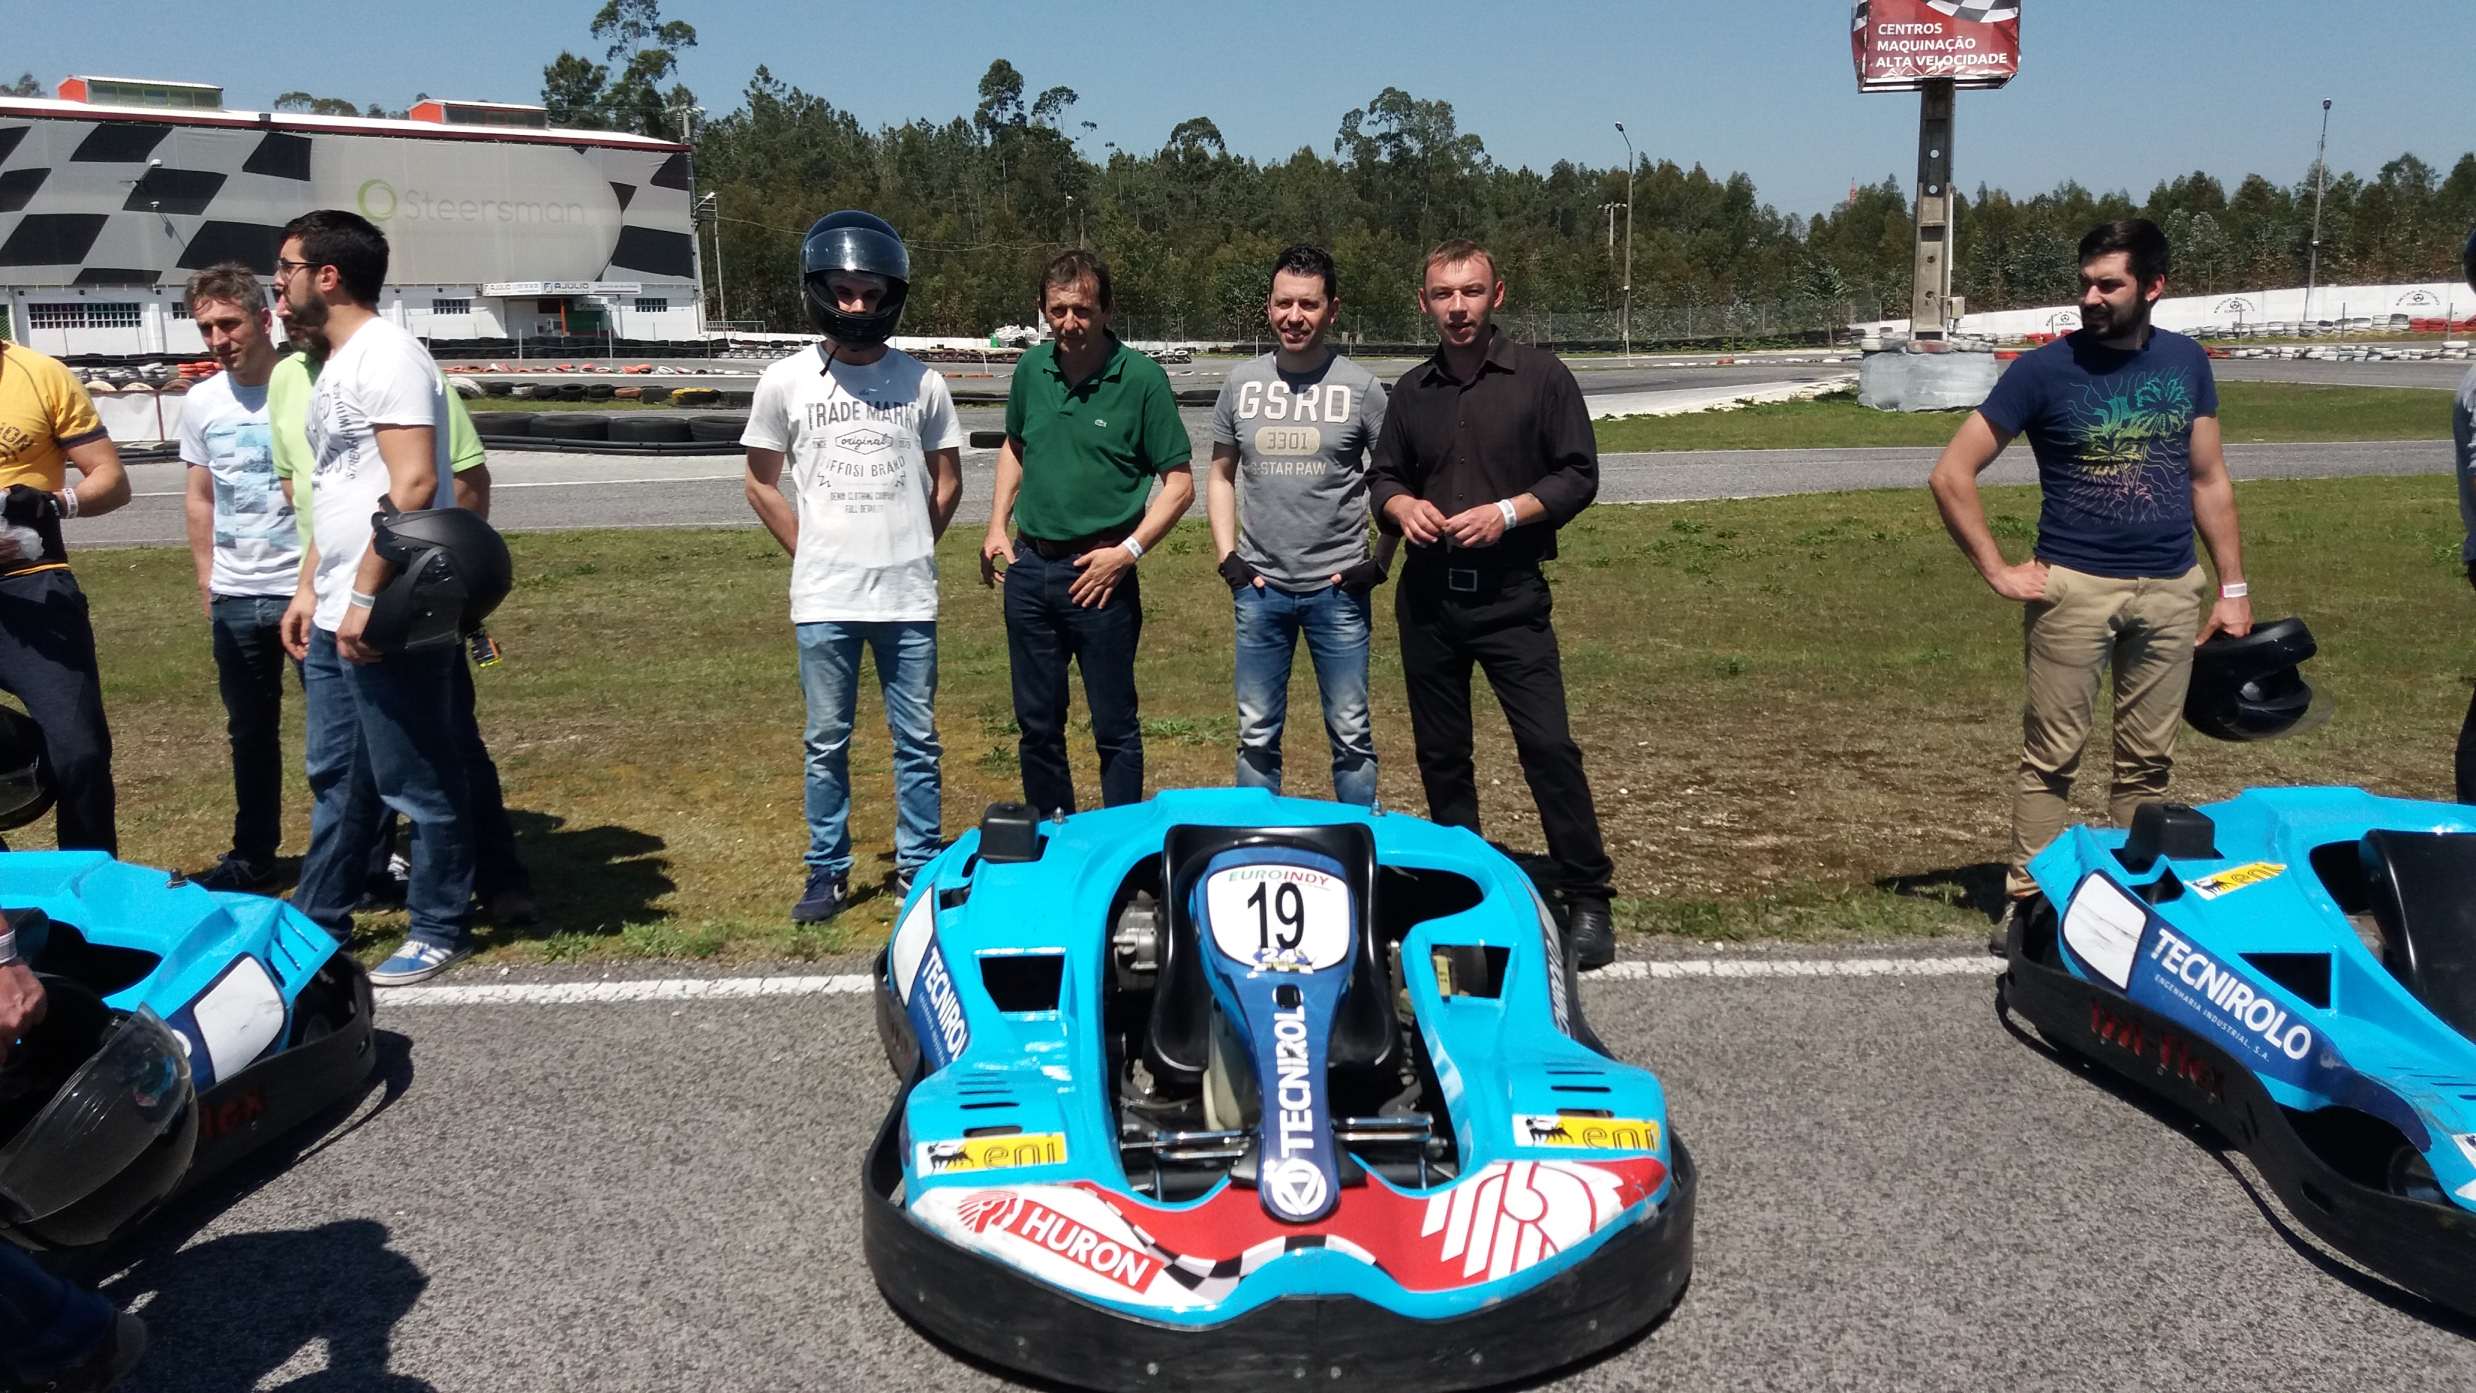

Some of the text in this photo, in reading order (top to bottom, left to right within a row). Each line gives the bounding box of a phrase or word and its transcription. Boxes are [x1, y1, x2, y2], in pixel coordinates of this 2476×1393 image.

[1878, 23, 1943, 36] CENTROS
[1876, 36, 1976, 53] MAQUINAÇÃO
[1875, 53, 2008, 68] ALTA VELOCIDADE
[405, 189, 585, 224] Steersman
[1238, 380, 1351, 423] GSRD
[805, 401, 861, 431] TRADE
[1267, 432, 1309, 450] 3301
[871, 455, 906, 477] BRAND
[1296, 462, 1327, 476] RAW
[1228, 869, 1330, 886] EUROINDY
[1247, 881, 1304, 949] 19
[2150, 928, 2312, 1060] TECNIROLO
[984, 1132, 1056, 1169] eni
[1020, 1206, 1151, 1287] HURON
